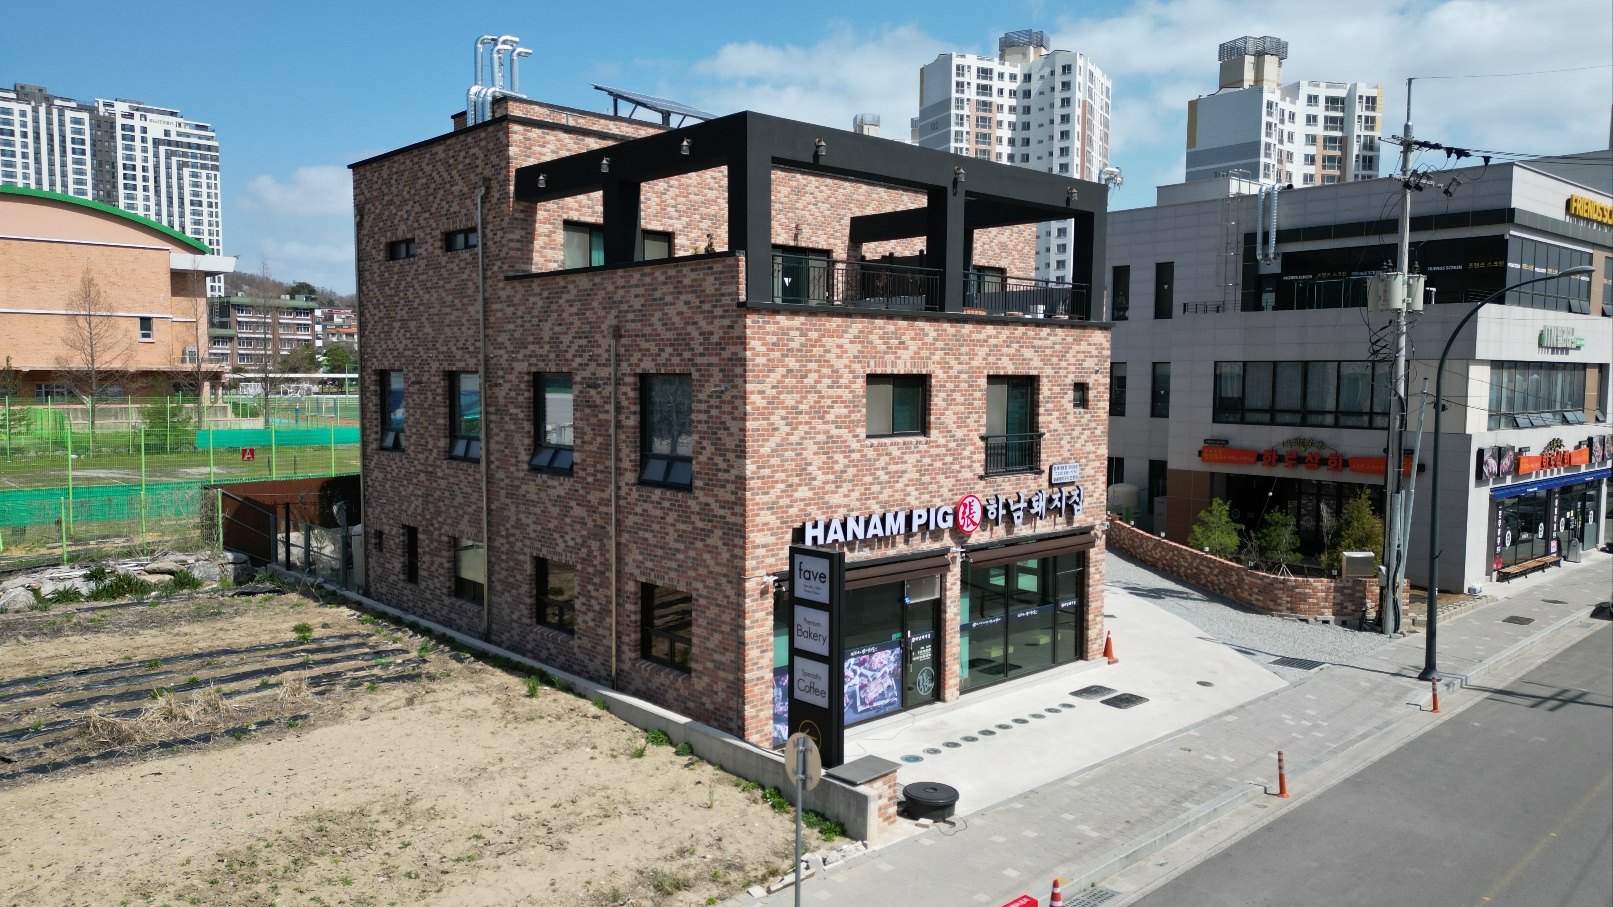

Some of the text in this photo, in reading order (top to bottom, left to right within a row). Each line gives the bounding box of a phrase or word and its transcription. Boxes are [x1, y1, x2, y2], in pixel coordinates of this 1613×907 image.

[243, 449, 254, 460] A
[986, 486, 1084, 526] 하남돼지집
[804, 505, 954, 546] HANAM PIG
[798, 561, 827, 584] fave
[803, 617, 822, 628] Premium
[796, 624, 828, 646] Bakery
[801, 668, 822, 682] Specialty
[796, 678, 827, 699] Coffee
